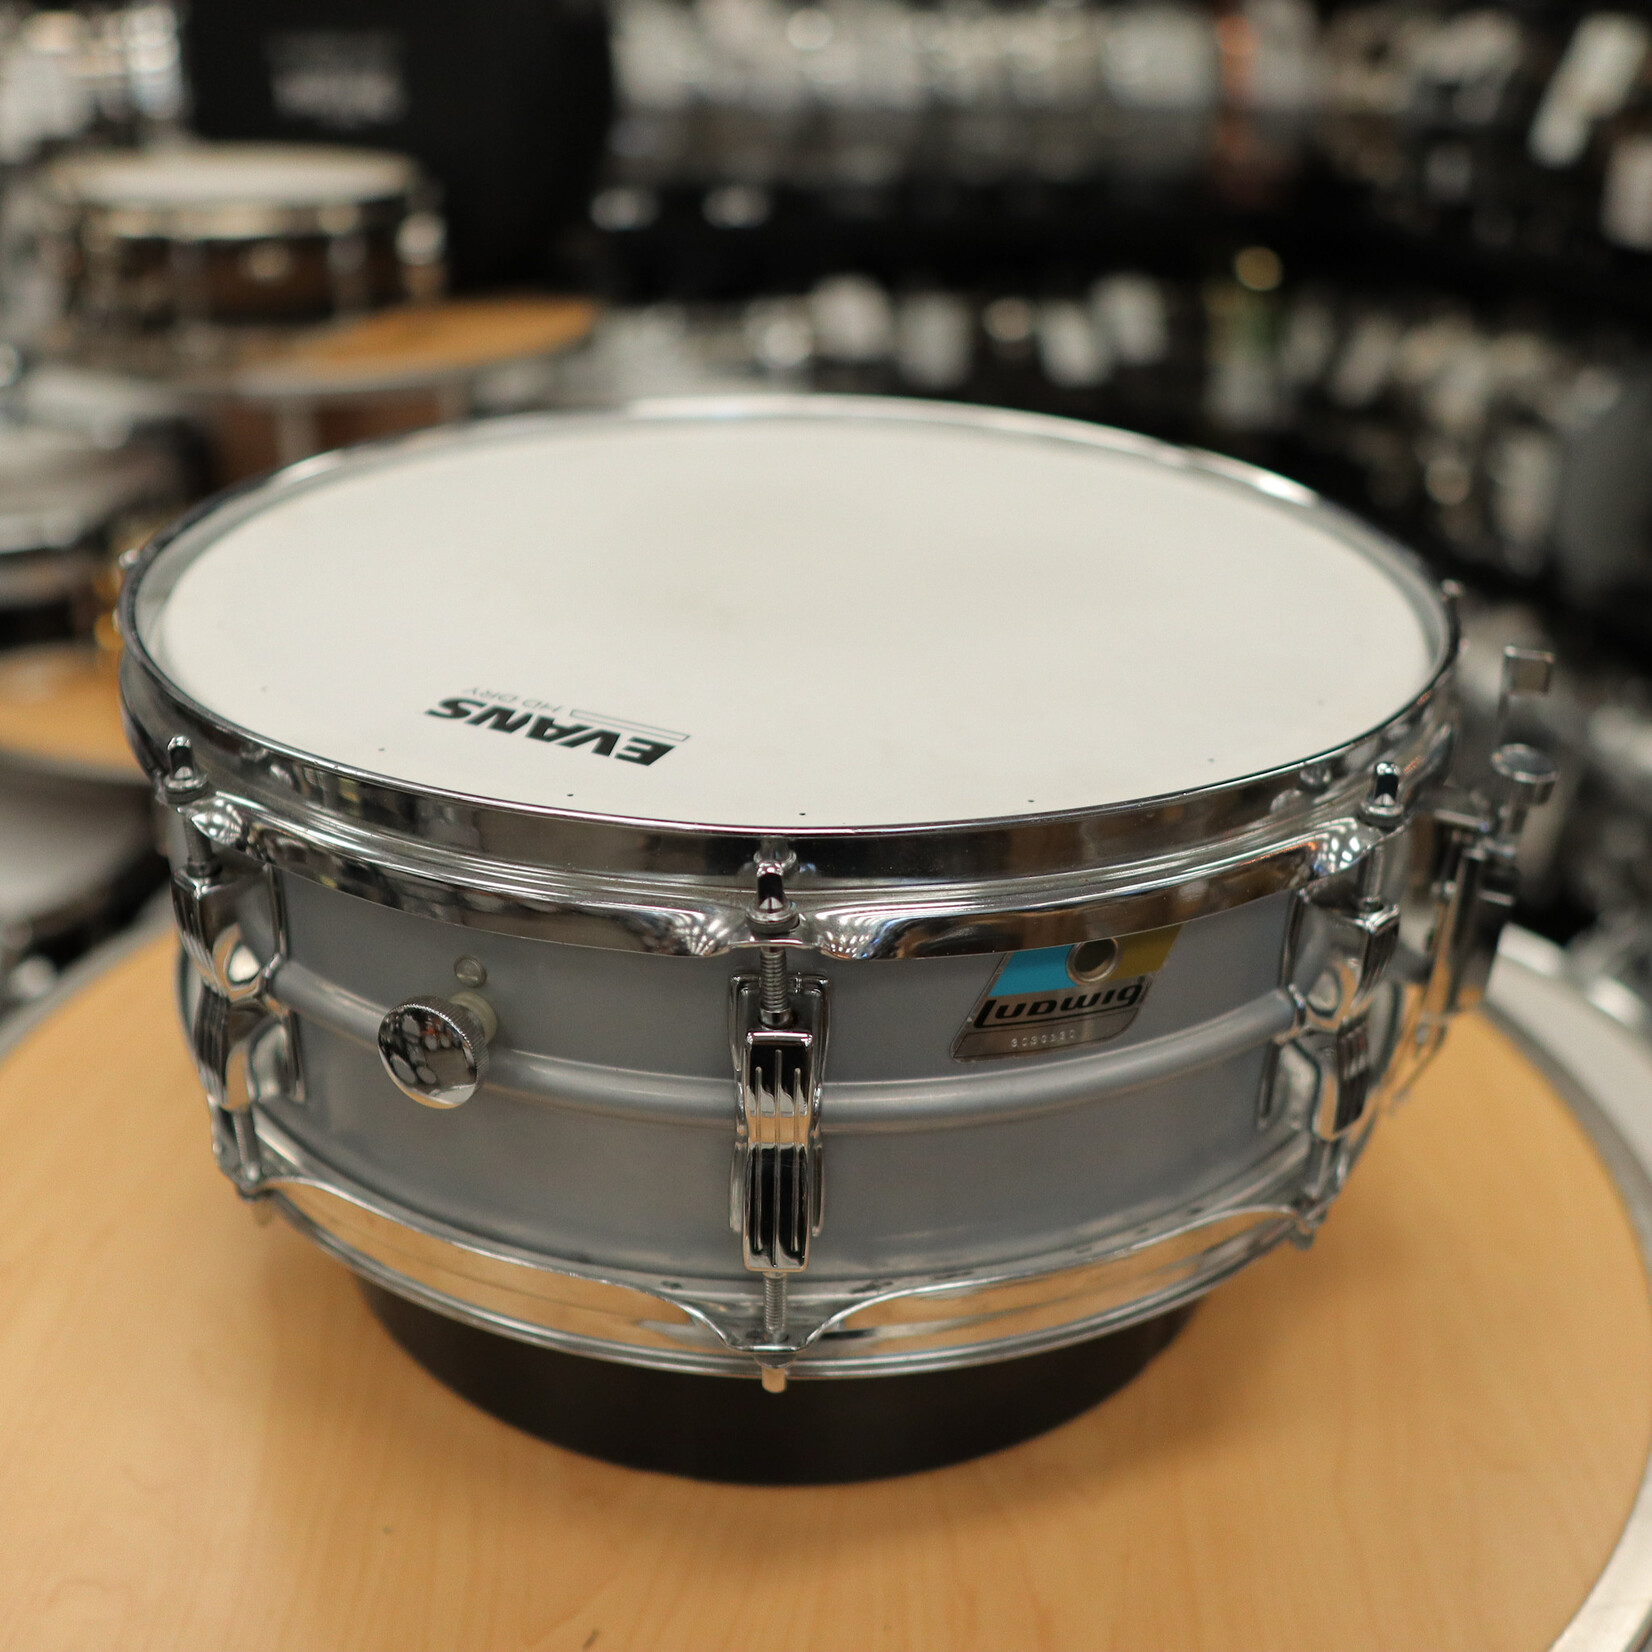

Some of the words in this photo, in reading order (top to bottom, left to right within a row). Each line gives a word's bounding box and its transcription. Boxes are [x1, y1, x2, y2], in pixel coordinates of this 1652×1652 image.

[522, 699, 563, 714] HD
[425, 697, 676, 766] EVANS
[974, 984, 1143, 1028] Ludwig
